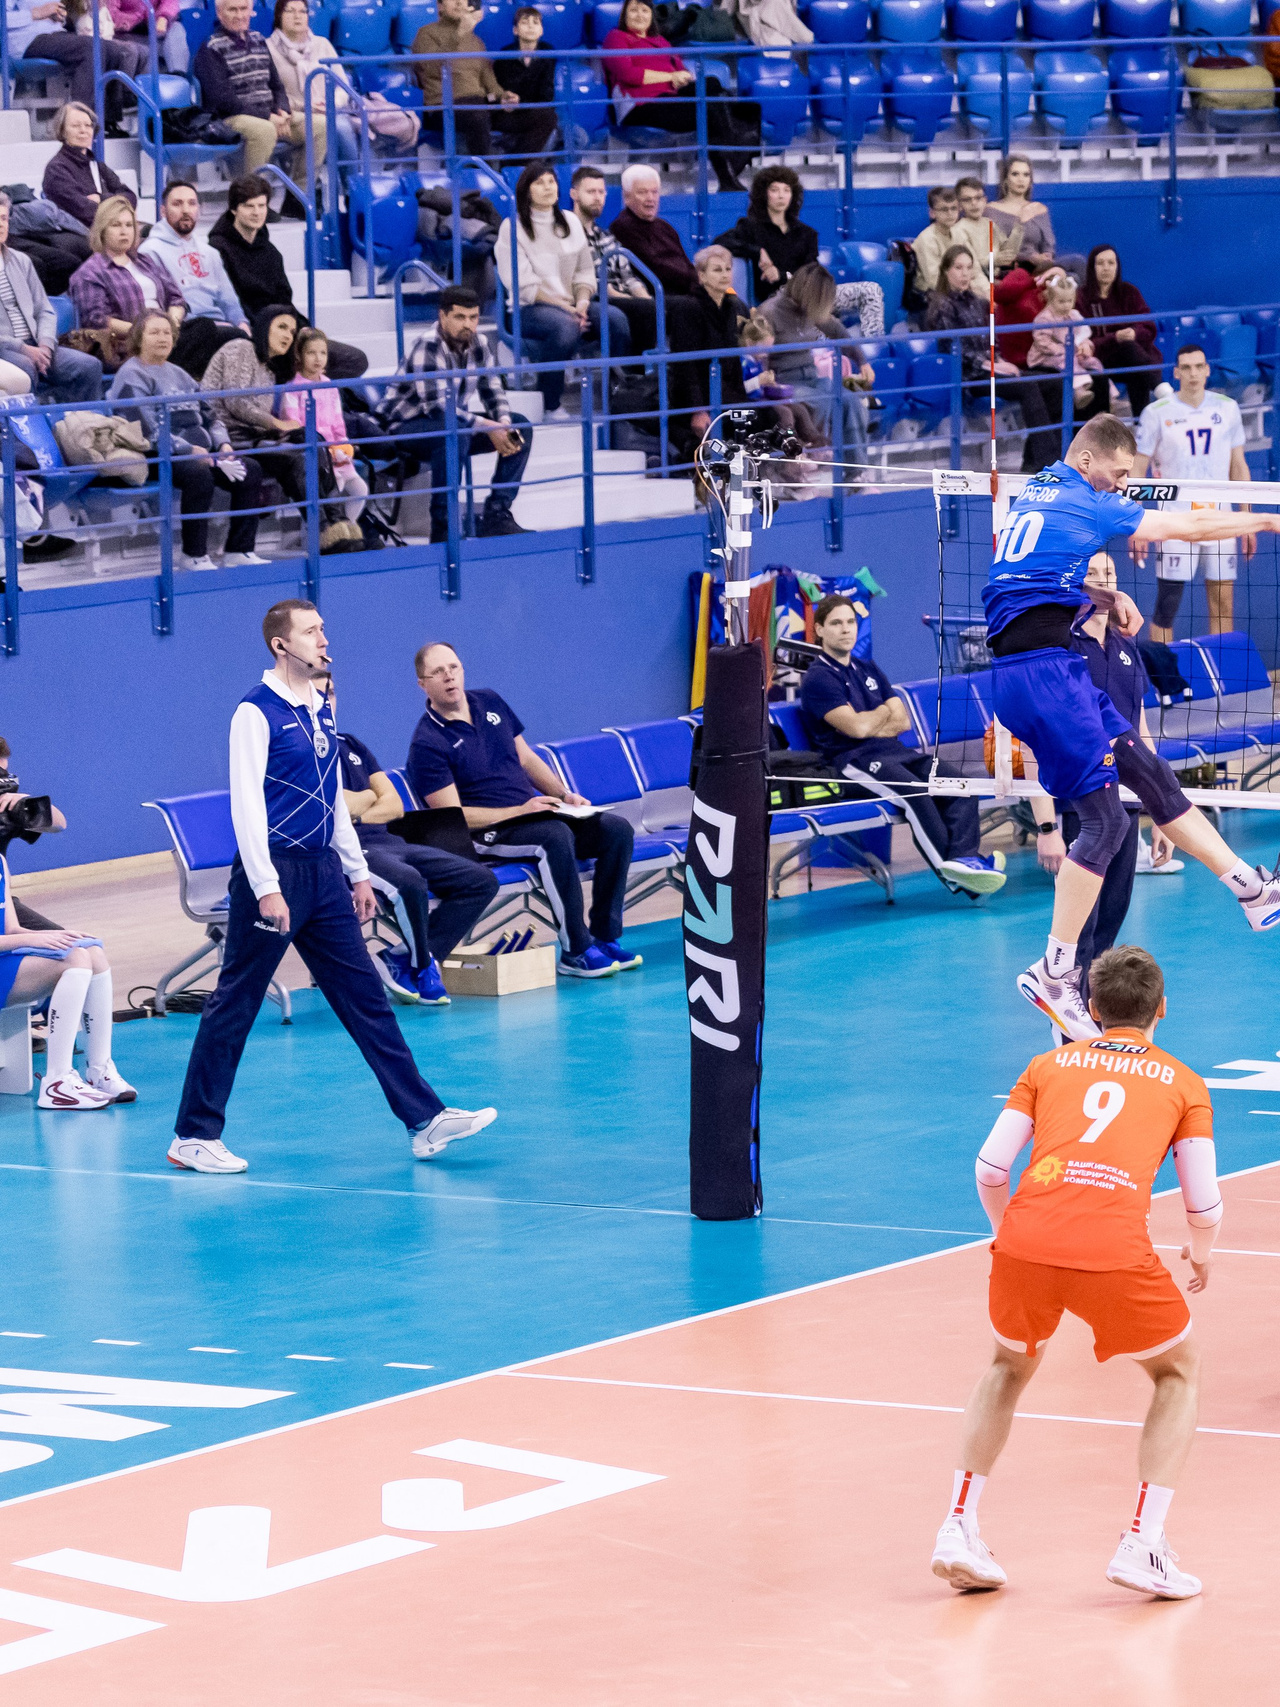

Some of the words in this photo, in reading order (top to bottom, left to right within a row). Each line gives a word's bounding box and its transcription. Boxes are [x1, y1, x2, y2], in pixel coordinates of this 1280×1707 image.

[1186, 428, 1212, 456] 17
[1126, 485, 1174, 500] PARI
[994, 511, 1045, 565] 10
[684, 795, 741, 1052] PARI
[1090, 1040, 1149, 1054] PARI
[1055, 1050, 1176, 1085] ЧАНЧИКОВ
[1078, 1080, 1126, 1144] 9
[1063, 1176, 1115, 1191] КОМПАНИЯ
[1067, 1159, 1130, 1180] БАШКИРСКАЯ
